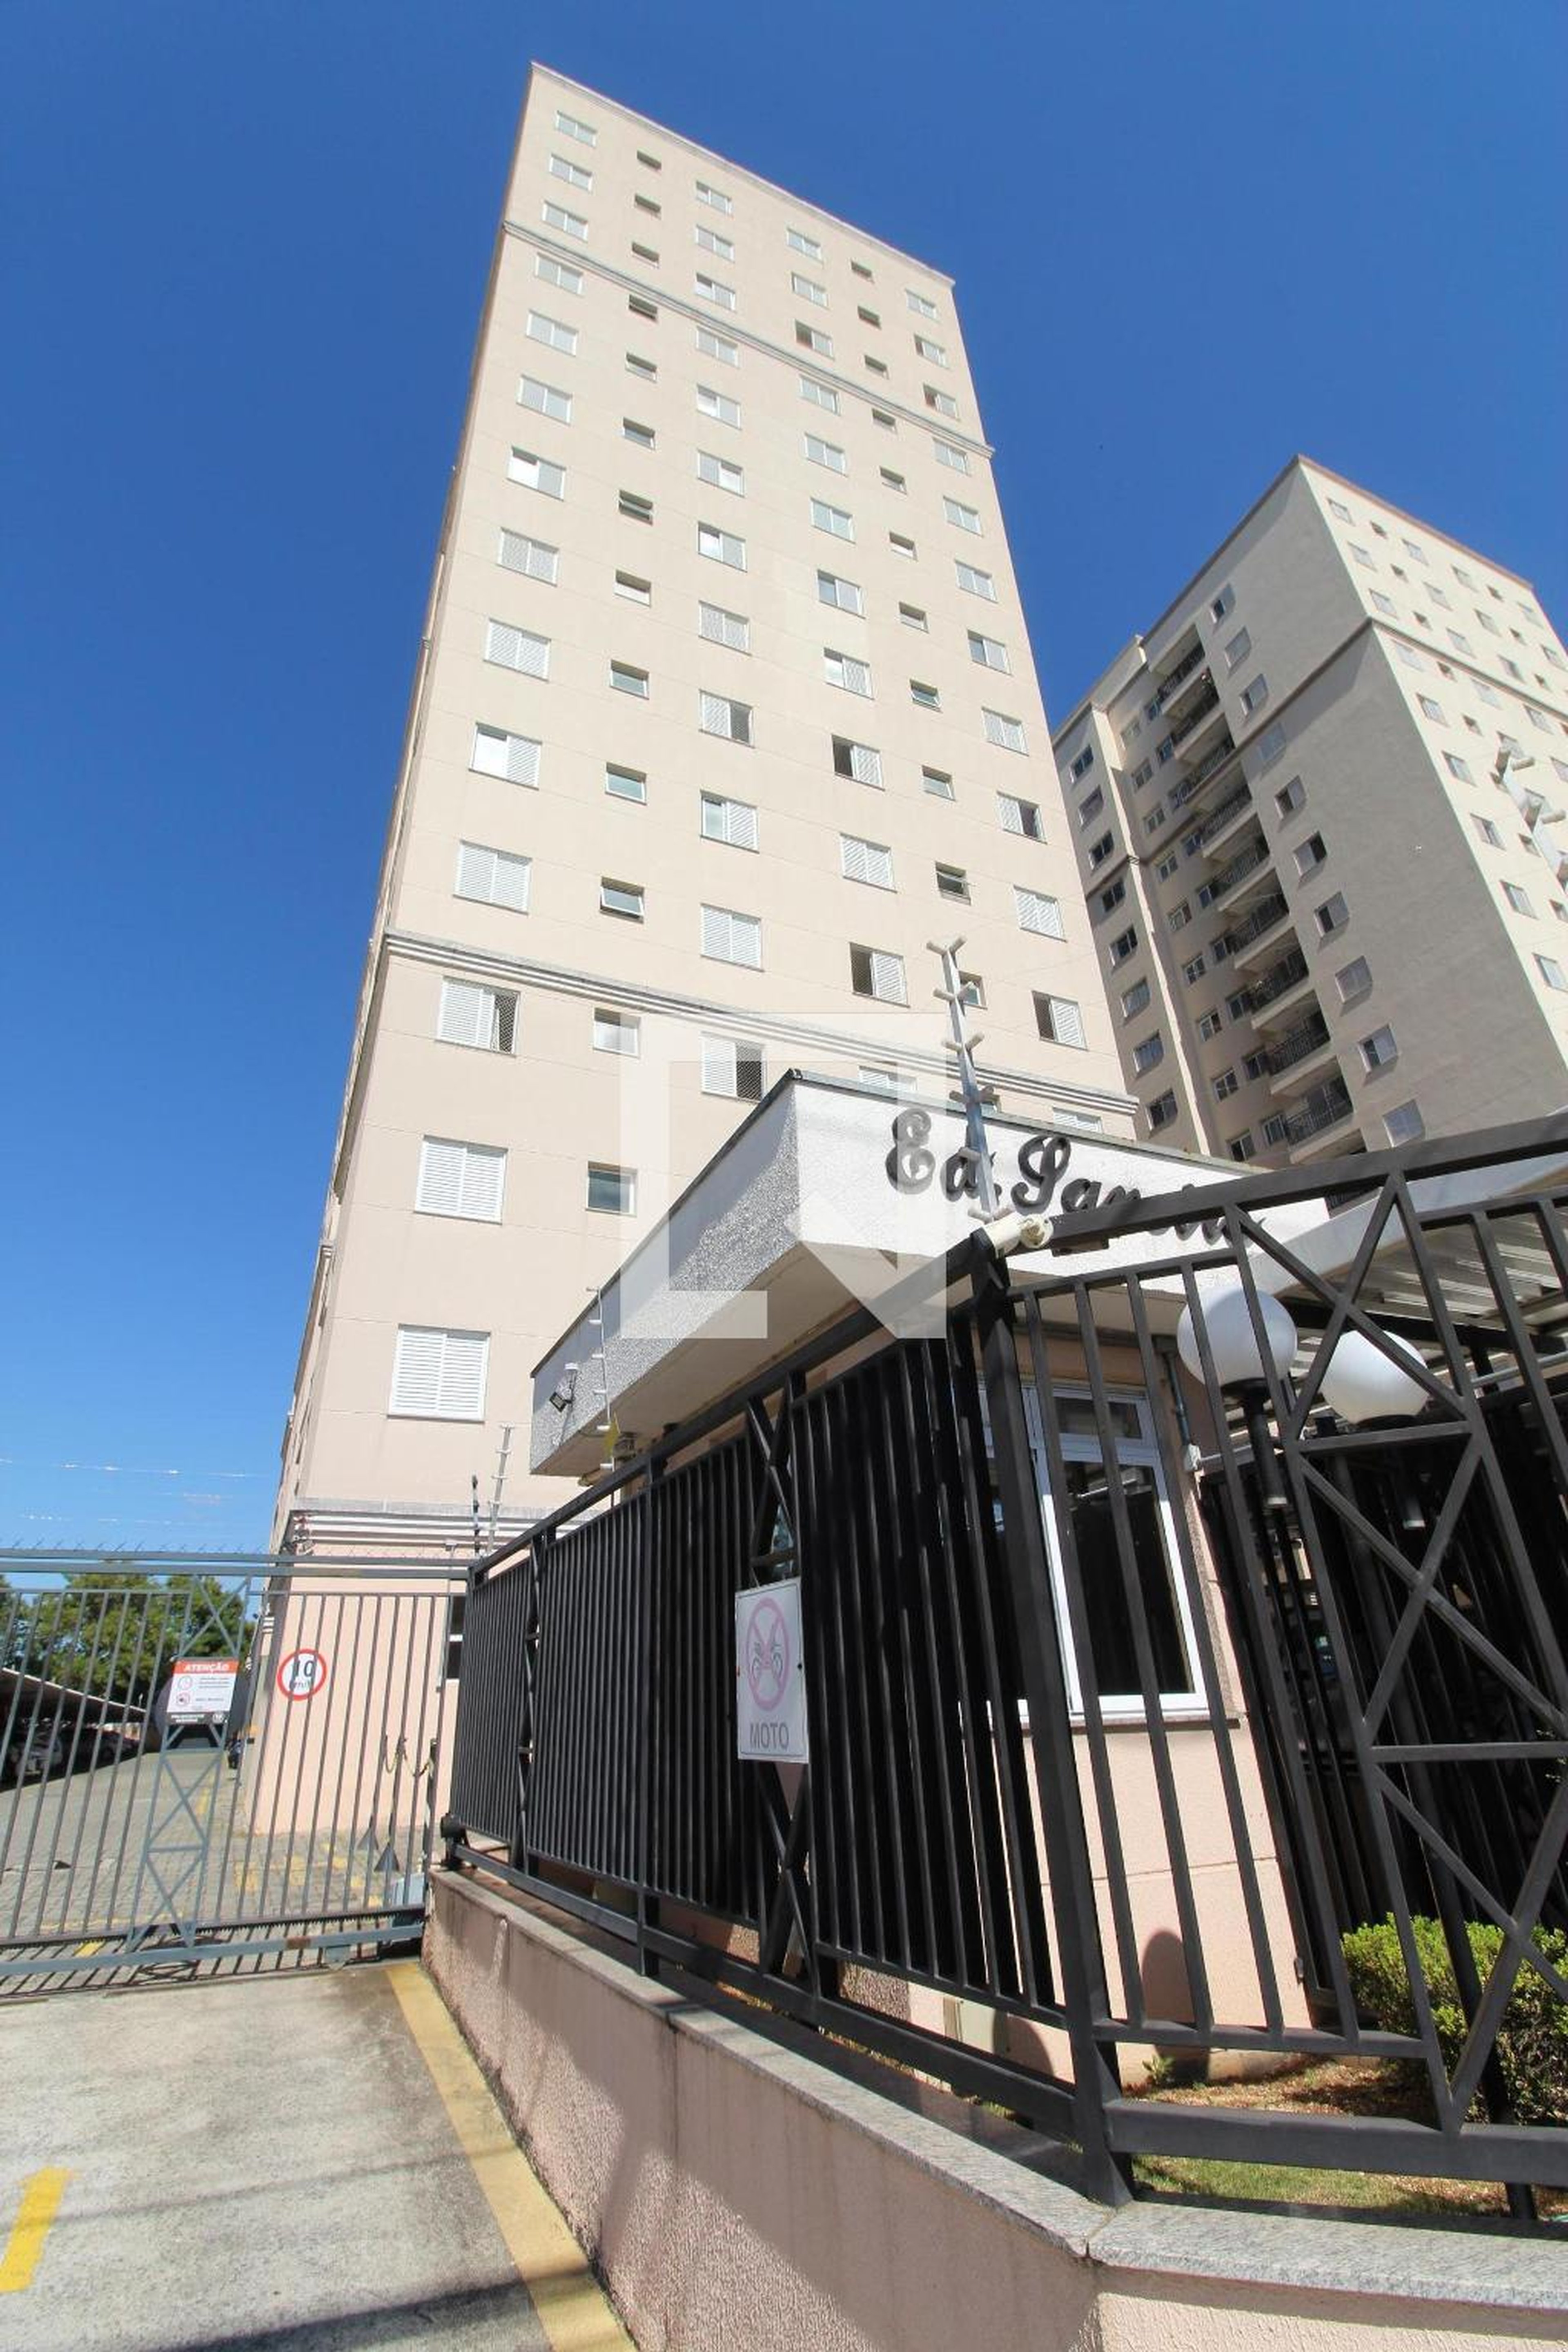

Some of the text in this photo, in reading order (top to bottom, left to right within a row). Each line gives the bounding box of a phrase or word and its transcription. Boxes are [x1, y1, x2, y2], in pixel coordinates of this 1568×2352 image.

[183, 1662, 230, 1673] ATENÇÃO
[293, 1660, 315, 1677] 10
[750, 1722, 789, 1750] MOTO
